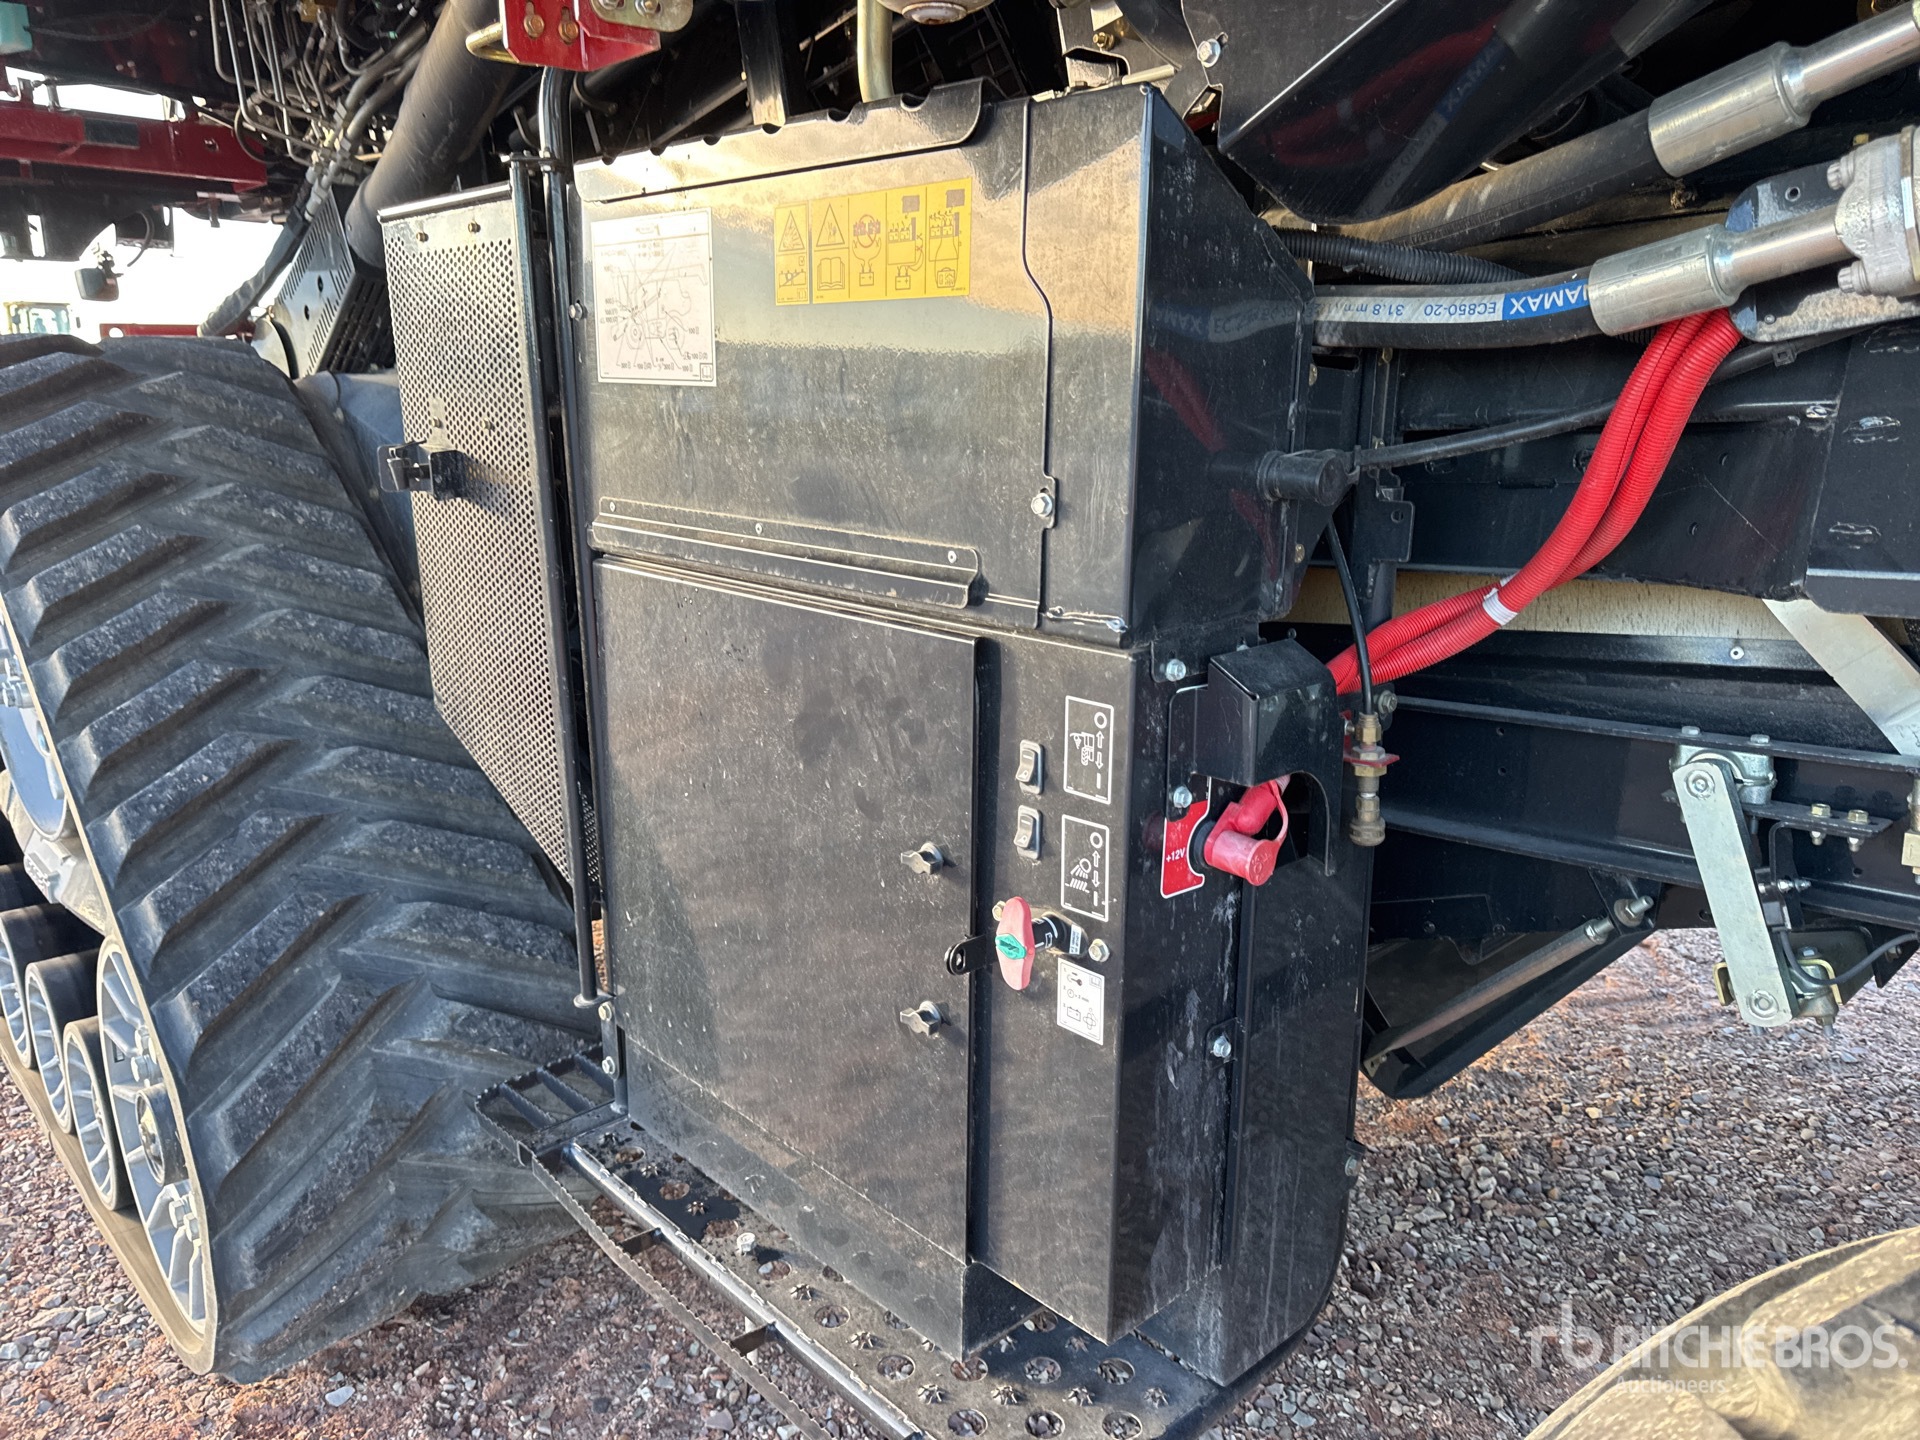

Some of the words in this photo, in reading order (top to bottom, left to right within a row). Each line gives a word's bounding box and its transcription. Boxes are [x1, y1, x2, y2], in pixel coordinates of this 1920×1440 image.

[1372, 303, 1404, 316] 31.8
[1423, 301, 1497, 316] EC850-20
[1166, 847, 1185, 863] +12V
